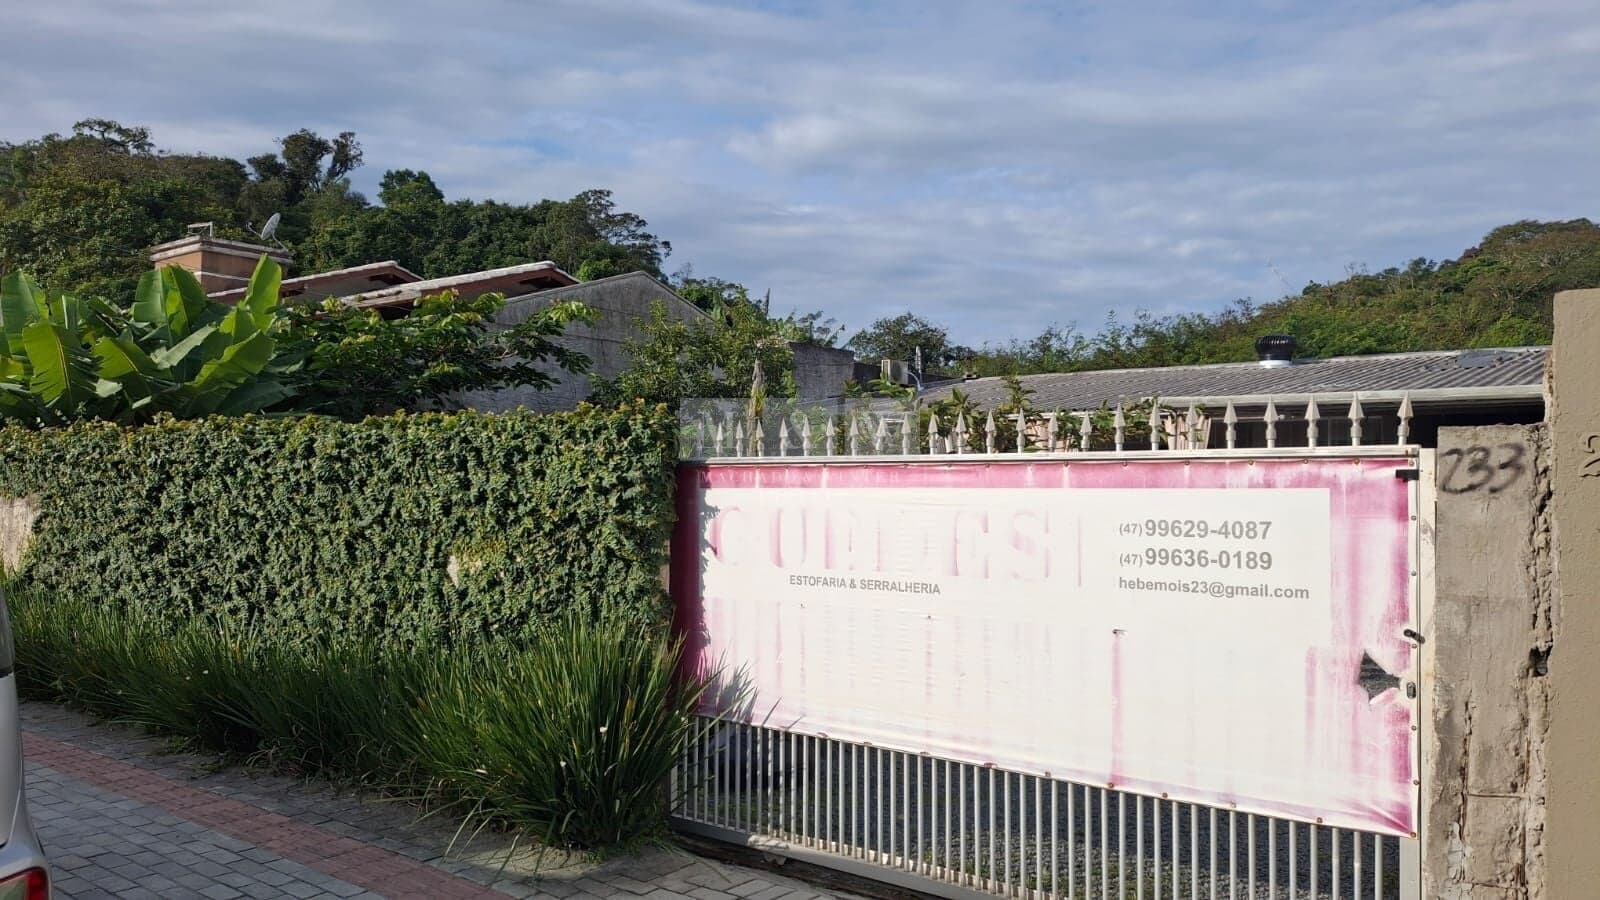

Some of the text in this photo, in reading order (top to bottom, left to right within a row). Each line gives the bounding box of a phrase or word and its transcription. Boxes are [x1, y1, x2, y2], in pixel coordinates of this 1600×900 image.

[1439, 443, 1525, 494] 233
[1119, 519, 1272, 540] (47) 99629-4087
[1119, 548, 1273, 570] (47) 99636-0189
[789, 574, 941, 595] ESTOFARIA & SERRALHERIA
[1119, 576, 1310, 599] hebemois23@gmail.com
